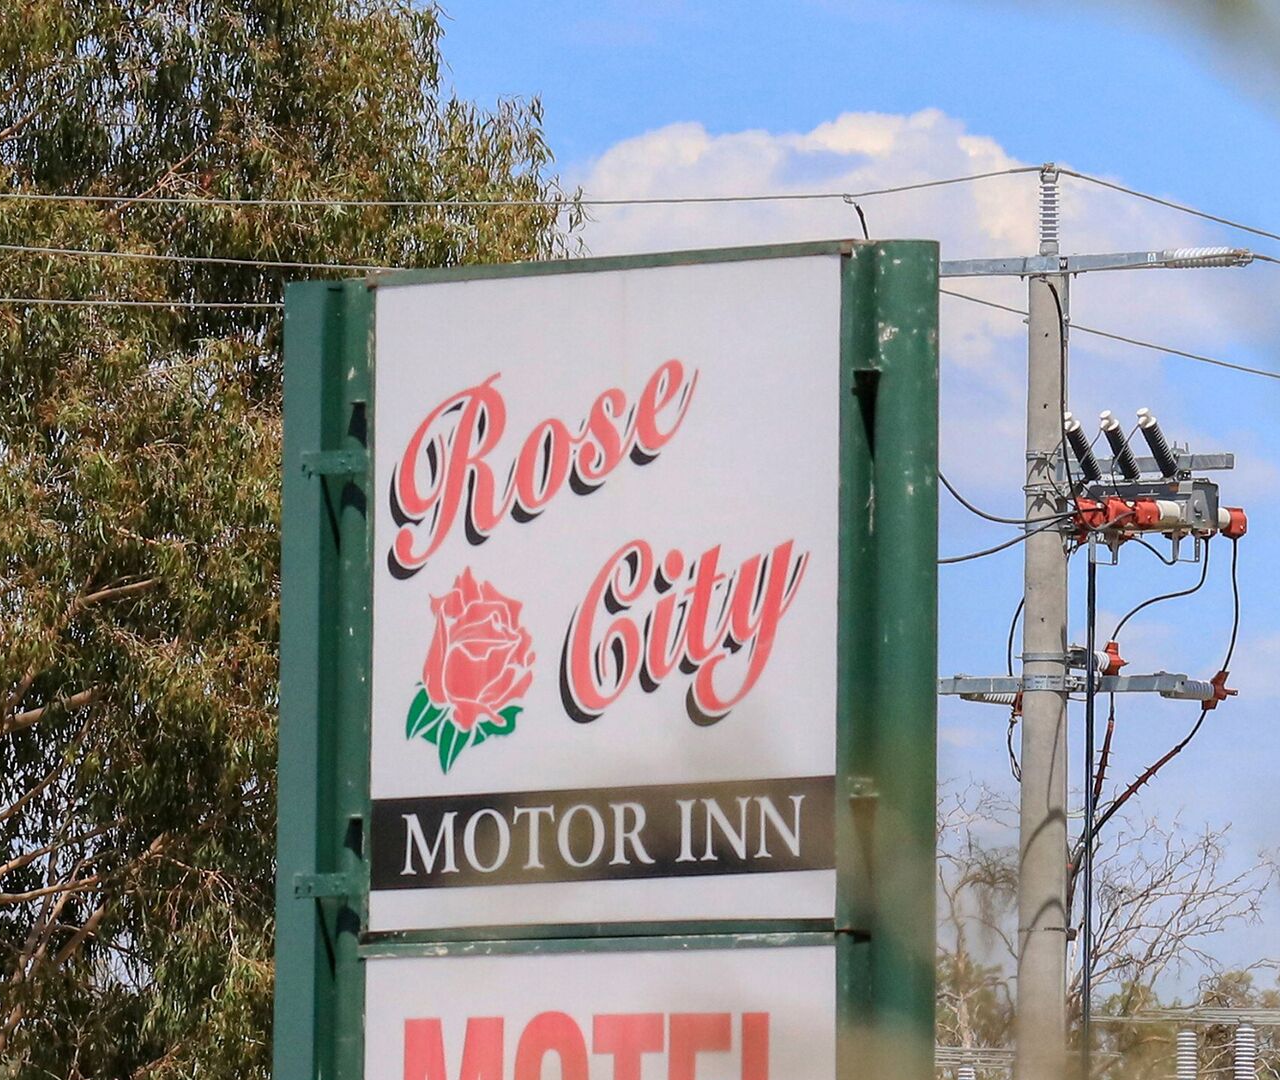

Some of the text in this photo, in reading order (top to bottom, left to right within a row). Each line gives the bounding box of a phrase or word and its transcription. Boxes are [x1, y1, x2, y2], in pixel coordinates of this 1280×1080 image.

[388, 358, 699, 580] Rose
[559, 538, 809, 727] City
[400, 794, 806, 876] MOTOR INN
